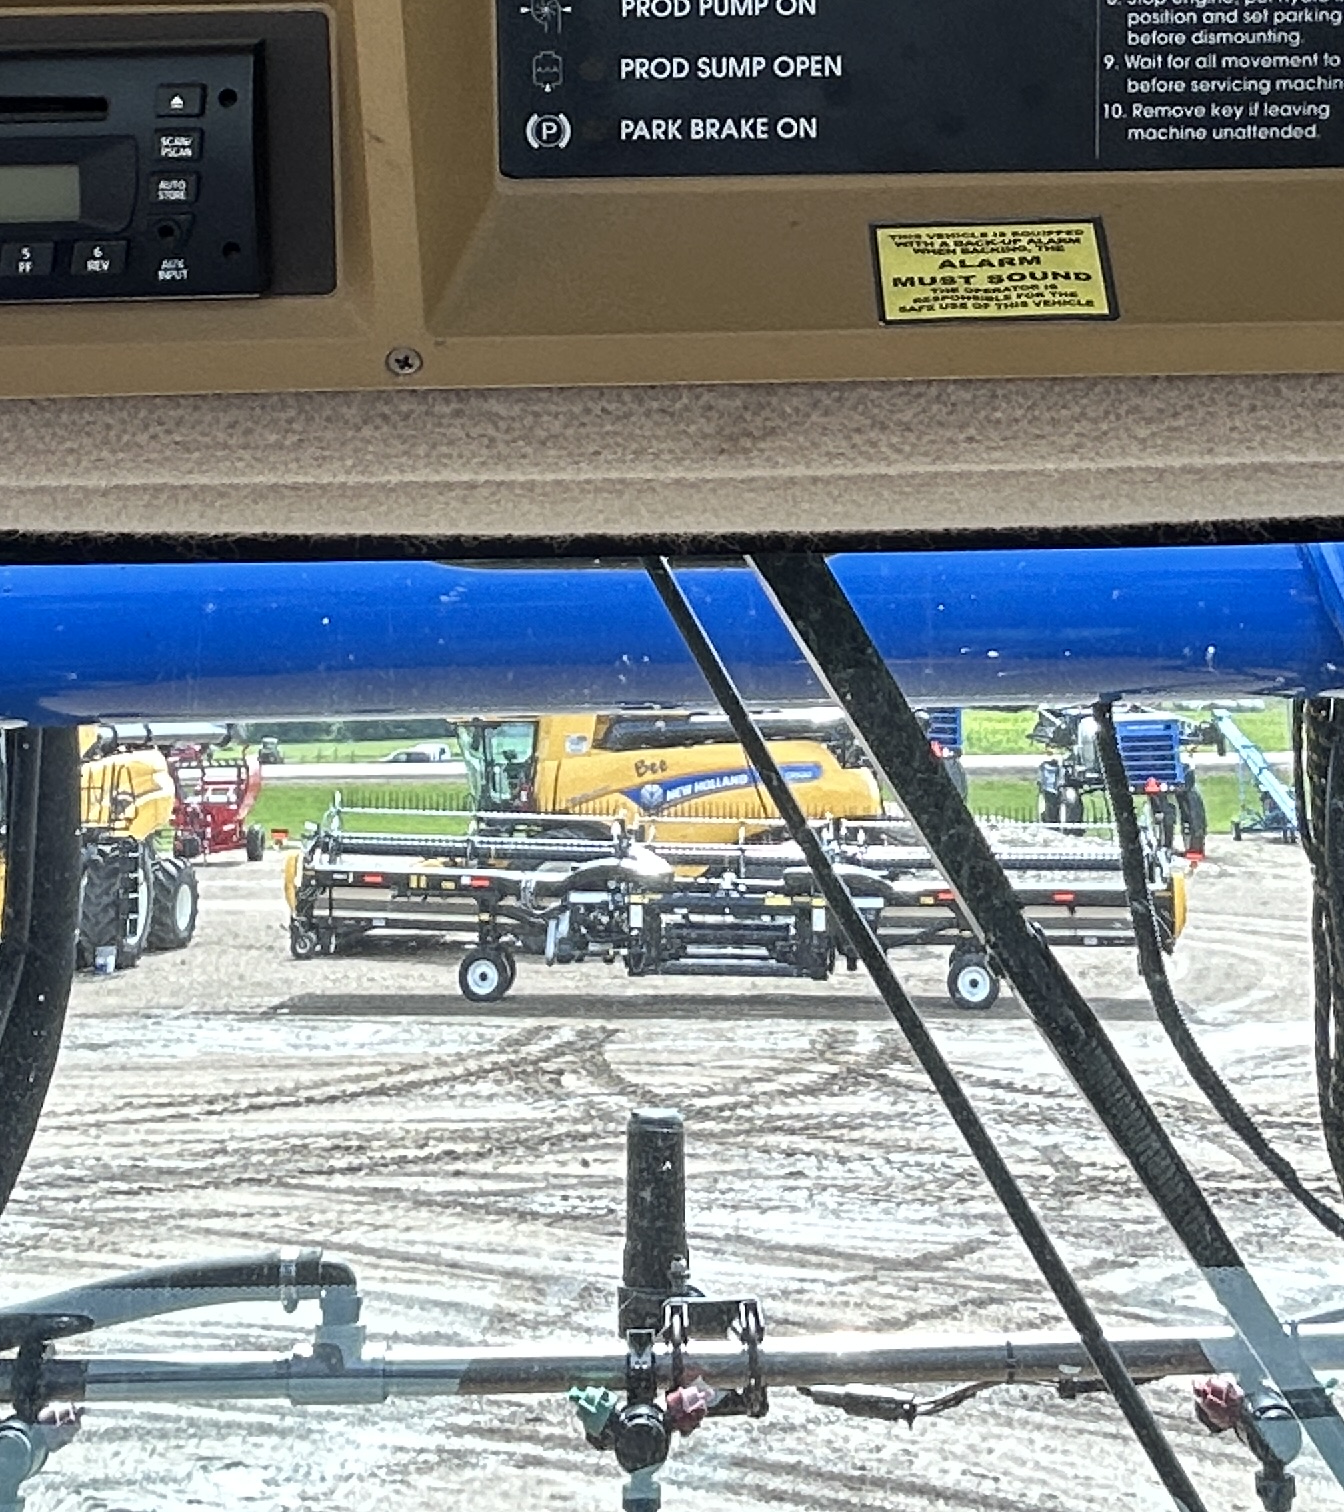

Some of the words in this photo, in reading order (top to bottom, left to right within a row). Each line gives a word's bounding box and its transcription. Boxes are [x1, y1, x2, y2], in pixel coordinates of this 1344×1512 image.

[620, 57, 689, 79] PROD
[697, 56, 765, 78] SUMP
[773, 56, 842, 77] OPEN
[1103, 104, 1127, 118] 10.
[1132, 104, 1206, 118] Remove
[1211, 103, 1243, 120] key
[1249, 102, 1259, 116] if
[1263, 102, 1330, 120] leaving
[542, 123, 557, 139] P
[620, 119, 682, 140] PARK
[690, 118, 769, 139] BRAKE
[776, 117, 817, 138] ON
[1127, 125, 1206, 140] machine
[1212, 124, 1320, 139] unattended.
[21, 247, 30, 258] 5
[93, 247, 102, 258] 6
[87, 259, 110, 271] REV
[938, 256, 1041, 269] ALARM
[892, 275, 976, 287] MUST
[987, 271, 1092, 284] SOUND
[634, 759, 668, 777] Bee
